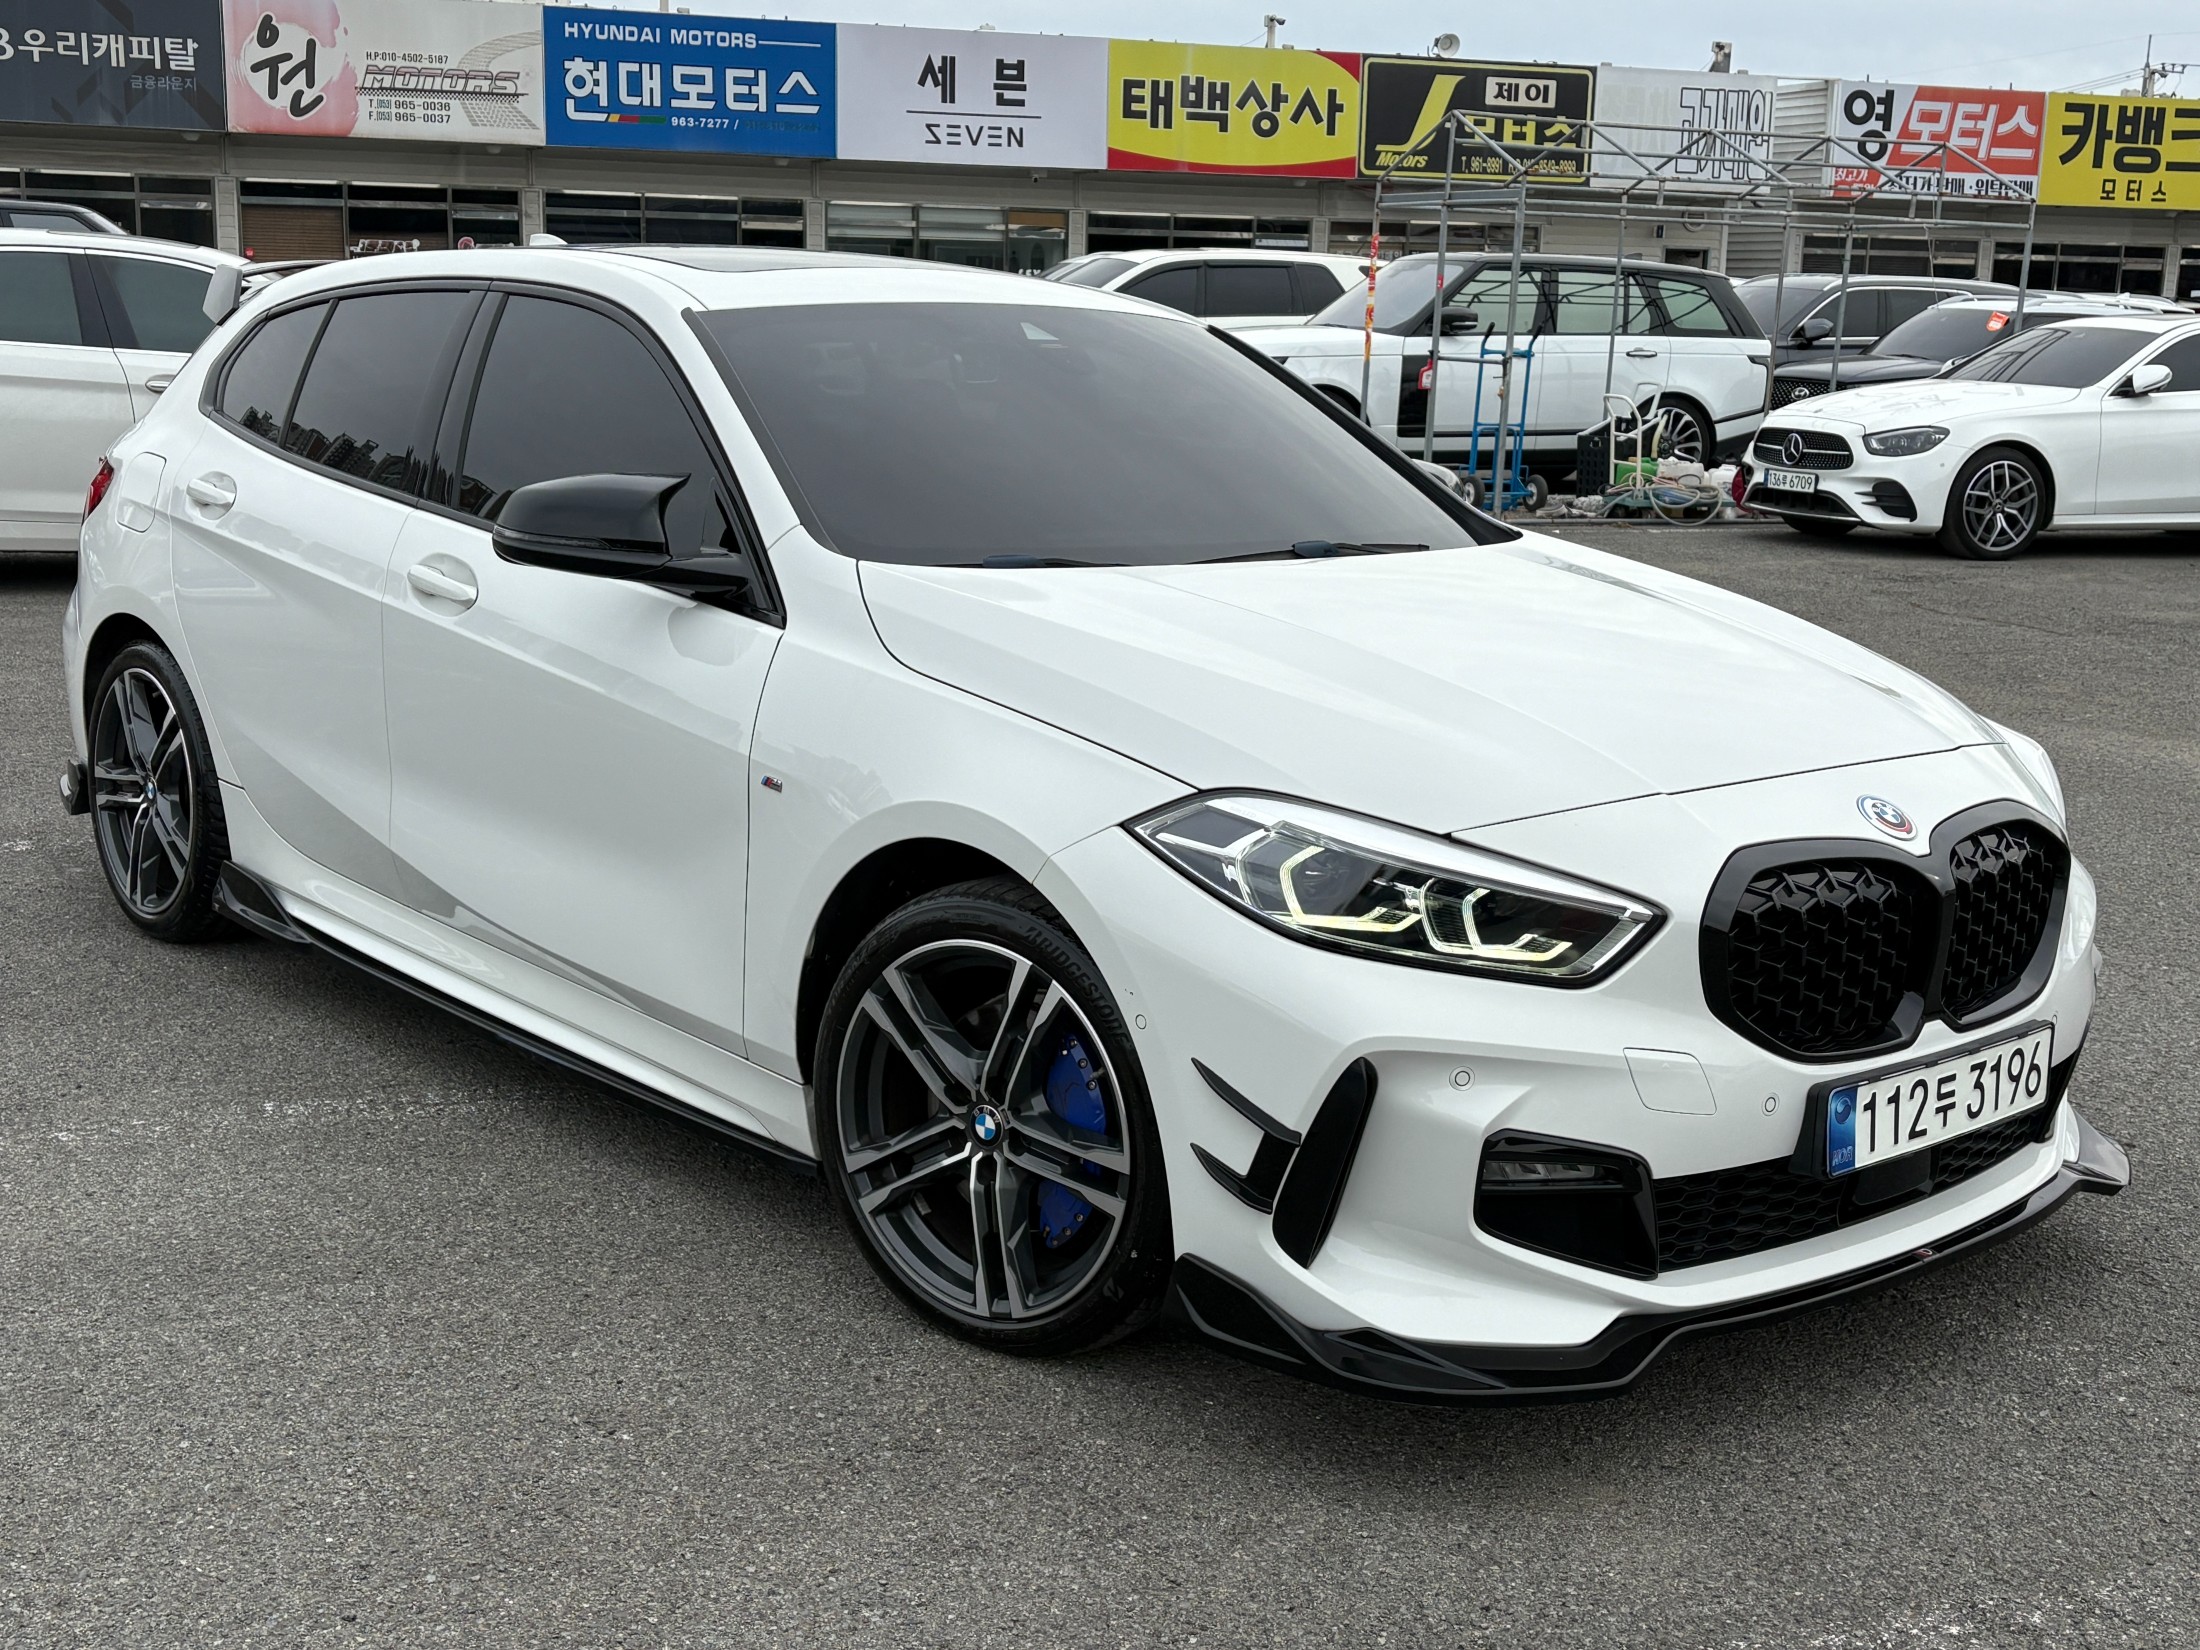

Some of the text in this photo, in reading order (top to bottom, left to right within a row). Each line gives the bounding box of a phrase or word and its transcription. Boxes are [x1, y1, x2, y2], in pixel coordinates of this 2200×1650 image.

[564, 22, 757, 48] HYUNDAI MOTORS
[250, 13, 324, 118] 원
[130, 75, 197, 92] 금융라운지
[361, 64, 520, 94] MOTORS
[563, 56, 821, 122] 현대모터스
[1493, 81, 1550, 104] 제이
[394, 99, 451, 112] 965-0036
[394, 111, 451, 124] 965-0037
[1122, 74, 1345, 138] 태백상사
[671, 116, 730, 129] 963-7277
[1843, 89, 2039, 162] 영 모터스
[925, 123, 1024, 148] SEVEN
[1375, 151, 1429, 168] Moors
[2099, 178, 2167, 202] 모터스
[1789, 475, 1813, 490] 6709
[1863, 1040, 2042, 1153] 112두 3196
[973, 1105, 1001, 1124] BMW
